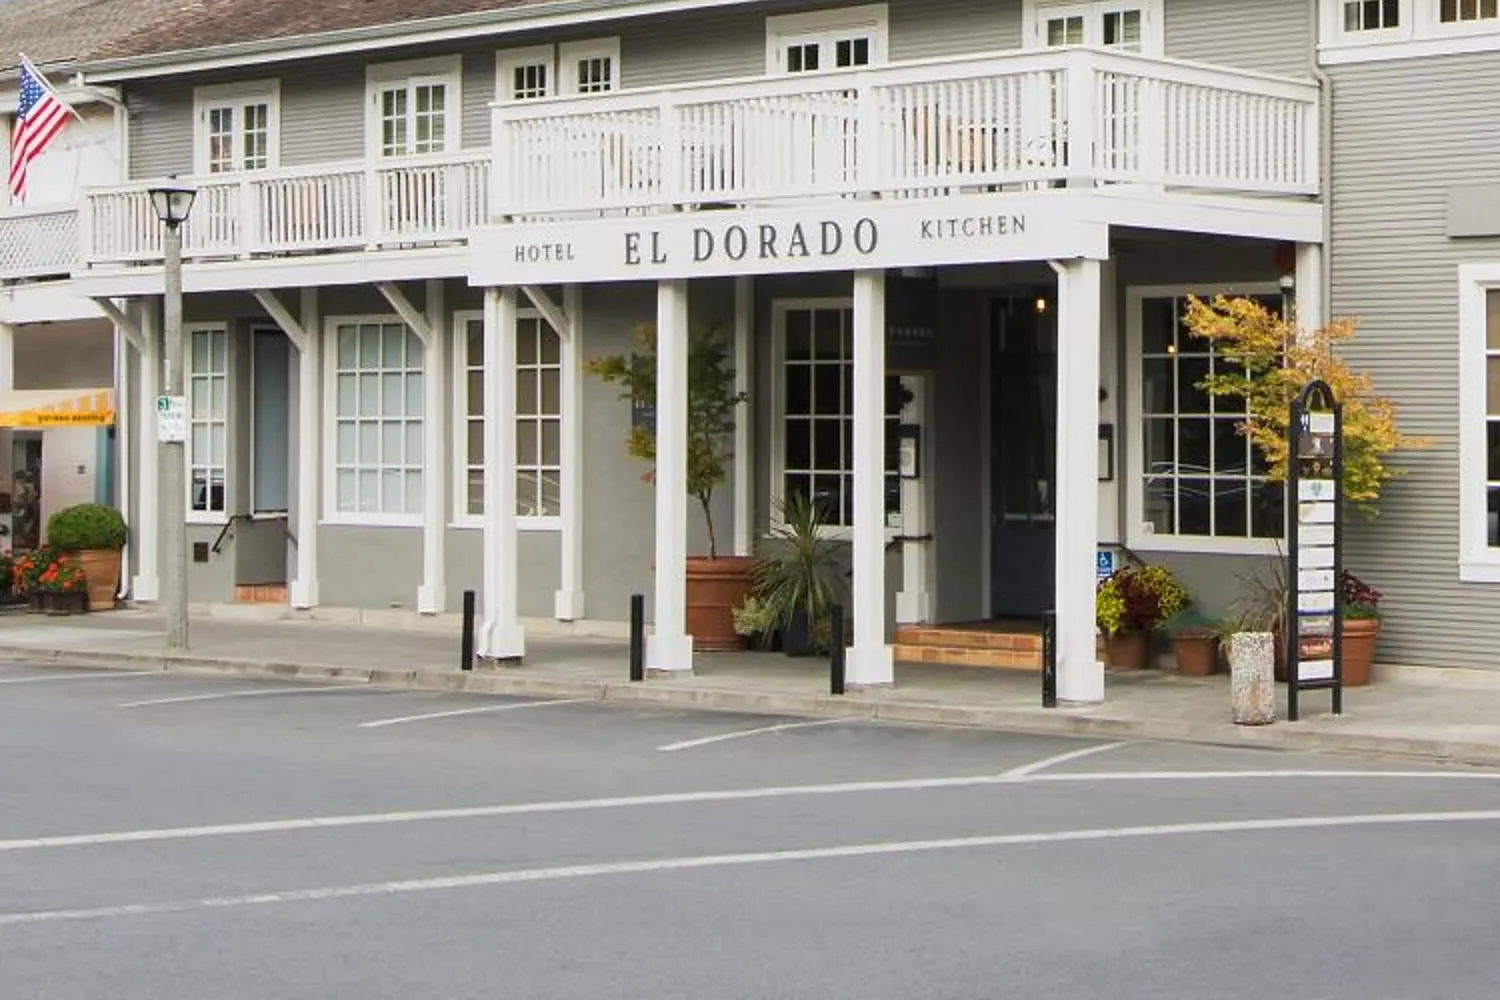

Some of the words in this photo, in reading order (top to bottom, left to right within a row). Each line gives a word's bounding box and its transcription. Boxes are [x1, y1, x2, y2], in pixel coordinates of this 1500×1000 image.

[515, 243, 575, 263] HOTEL
[625, 231, 668, 265] EL
[693, 217, 878, 262] DORADO
[920, 214, 1026, 239] KITCHEN
